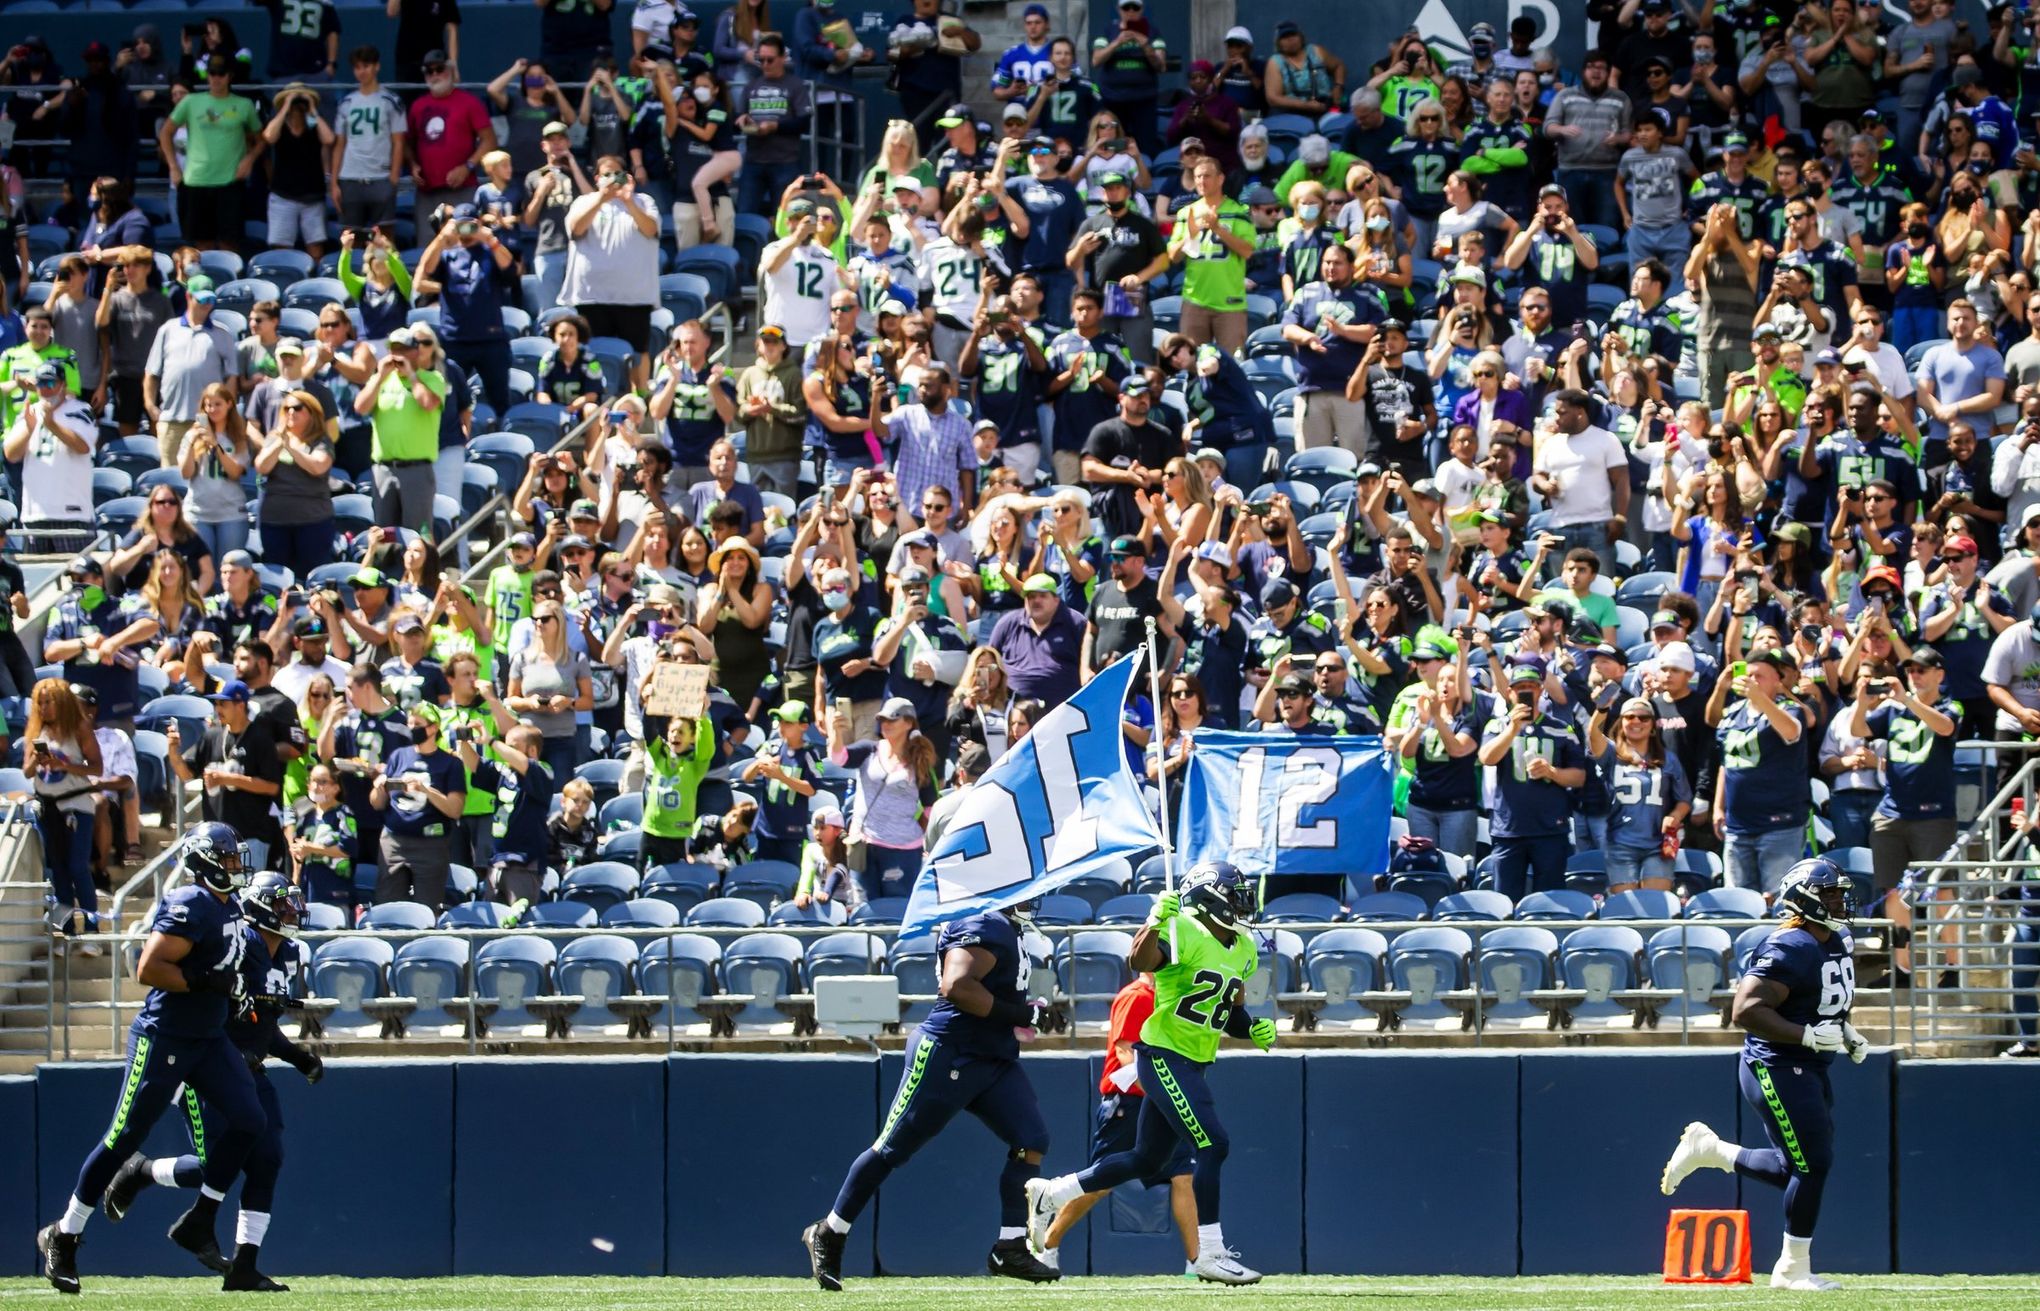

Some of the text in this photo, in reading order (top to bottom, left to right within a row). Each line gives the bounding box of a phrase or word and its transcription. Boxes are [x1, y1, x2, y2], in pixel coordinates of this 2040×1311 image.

[279, 1, 322, 39] 33
[351, 107, 380, 136] 24
[1051, 90, 1078, 122] 12
[1411, 155, 1445, 193] 12
[793, 261, 822, 298] 12
[937, 258, 980, 297] 24
[1538, 242, 1573, 282] 14
[980, 352, 1017, 392] 31
[1839, 456, 1885, 490] 54
[1887, 716, 1933, 764] 20
[1231, 746, 1343, 851] 12
[1613, 767, 1662, 805] 51
[1173, 969, 1237, 1032] 28
[1814, 957, 1853, 1017] 68
[1677, 1215, 1734, 1279] 10
